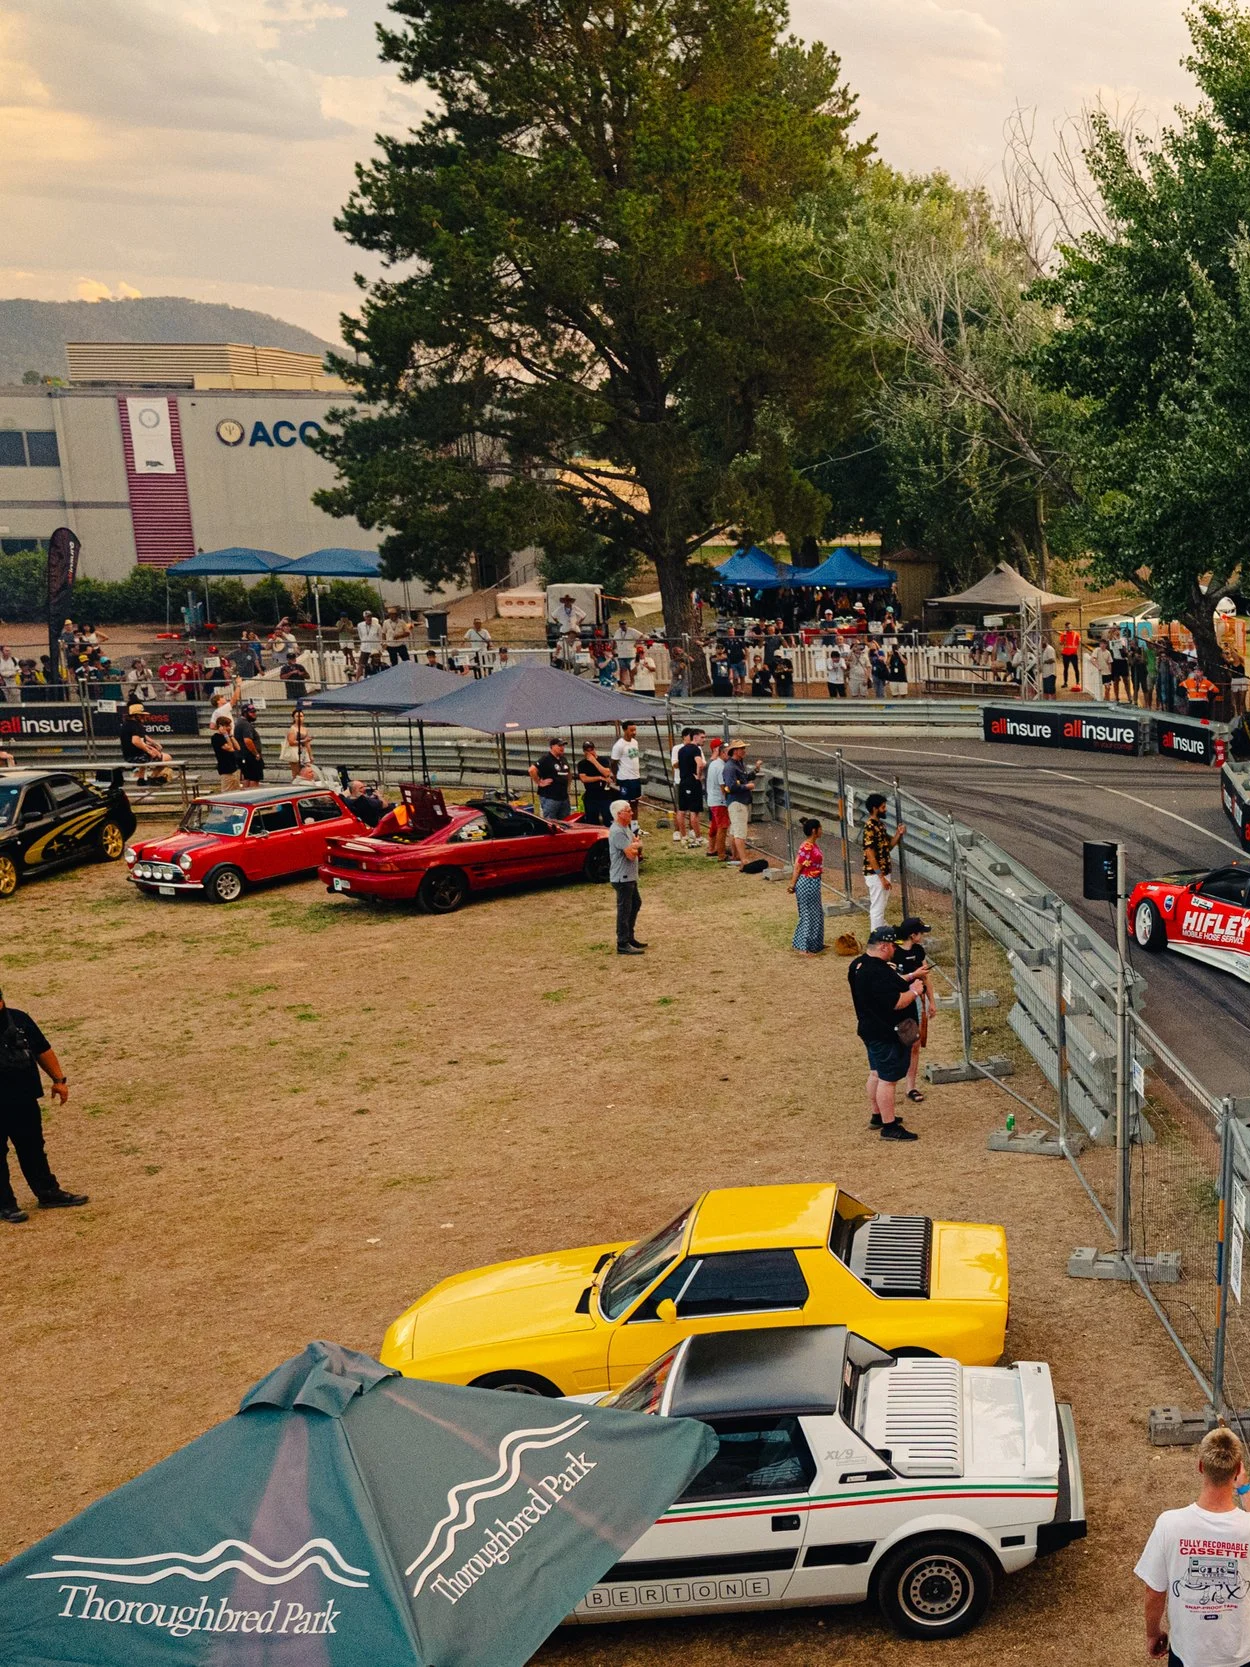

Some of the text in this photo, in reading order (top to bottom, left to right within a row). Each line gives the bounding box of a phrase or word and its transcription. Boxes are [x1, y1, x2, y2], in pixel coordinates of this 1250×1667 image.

[1, 716, 84, 734] allinsure
[991, 717, 1052, 739] allinsure
[1063, 719, 1135, 743] allinsure
[1162, 730, 1205, 755] allinsure
[1182, 929, 1245, 945] MOBILE HOSE SERVICE
[430, 1451, 598, 1605] Thoroughbred Park
[1180, 1539, 1249, 1552] FULLY RECORDABLE
[1180, 1547, 1248, 1559] CASSETTE
[592, 1581, 763, 1605] BERTONE
[58, 1584, 341, 1637] Thoroughbred Park
